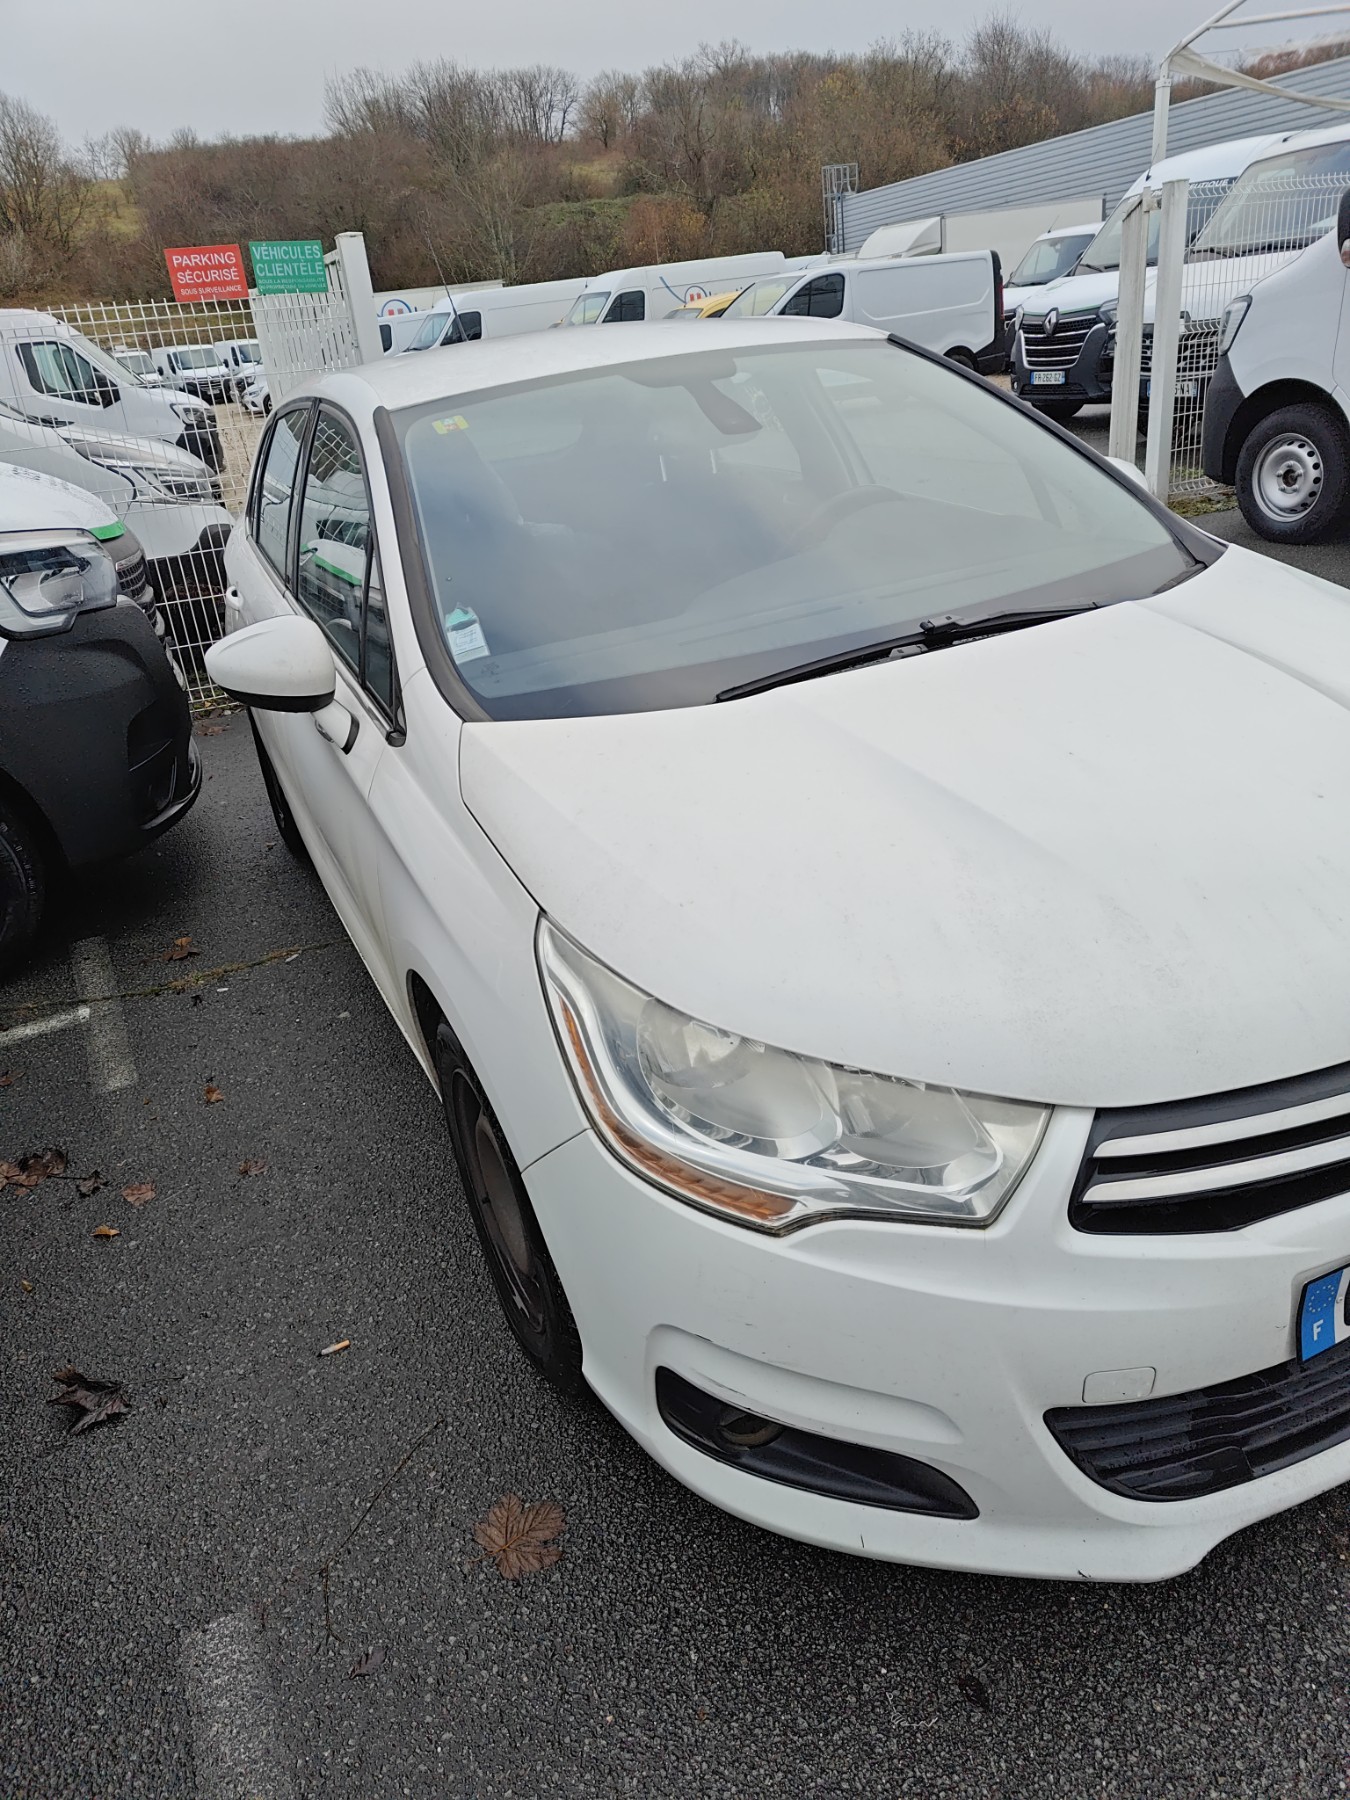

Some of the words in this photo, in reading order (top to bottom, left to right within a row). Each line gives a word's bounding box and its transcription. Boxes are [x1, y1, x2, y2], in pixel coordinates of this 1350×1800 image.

[172, 252, 236, 268] PARKING
[252, 243, 321, 260] VÉHICULES
[177, 266, 240, 284] SÉCURISÉ
[256, 258, 324, 277] CLIENTÈLE
[181, 287, 198, 295] SOUS
[199, 285, 242, 294] SURVEILLANCE
[1312, 1319, 1324, 1341] F
